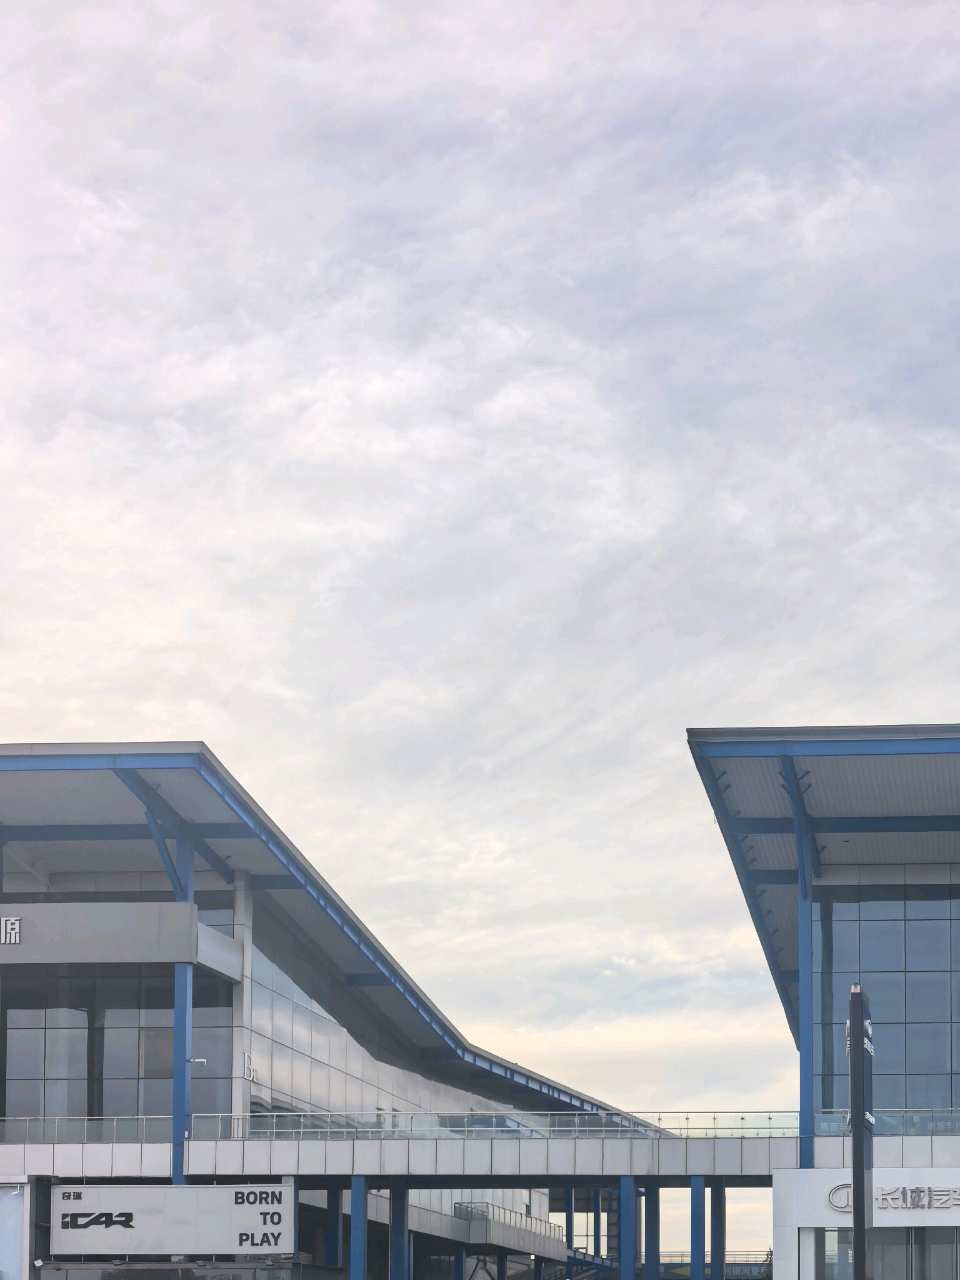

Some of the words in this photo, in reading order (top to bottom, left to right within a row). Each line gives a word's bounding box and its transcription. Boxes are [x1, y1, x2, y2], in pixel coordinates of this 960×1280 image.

[234, 1191, 283, 1205] BORN
[259, 1212, 282, 1226] TO
[238, 1232, 282, 1247] PLAY
